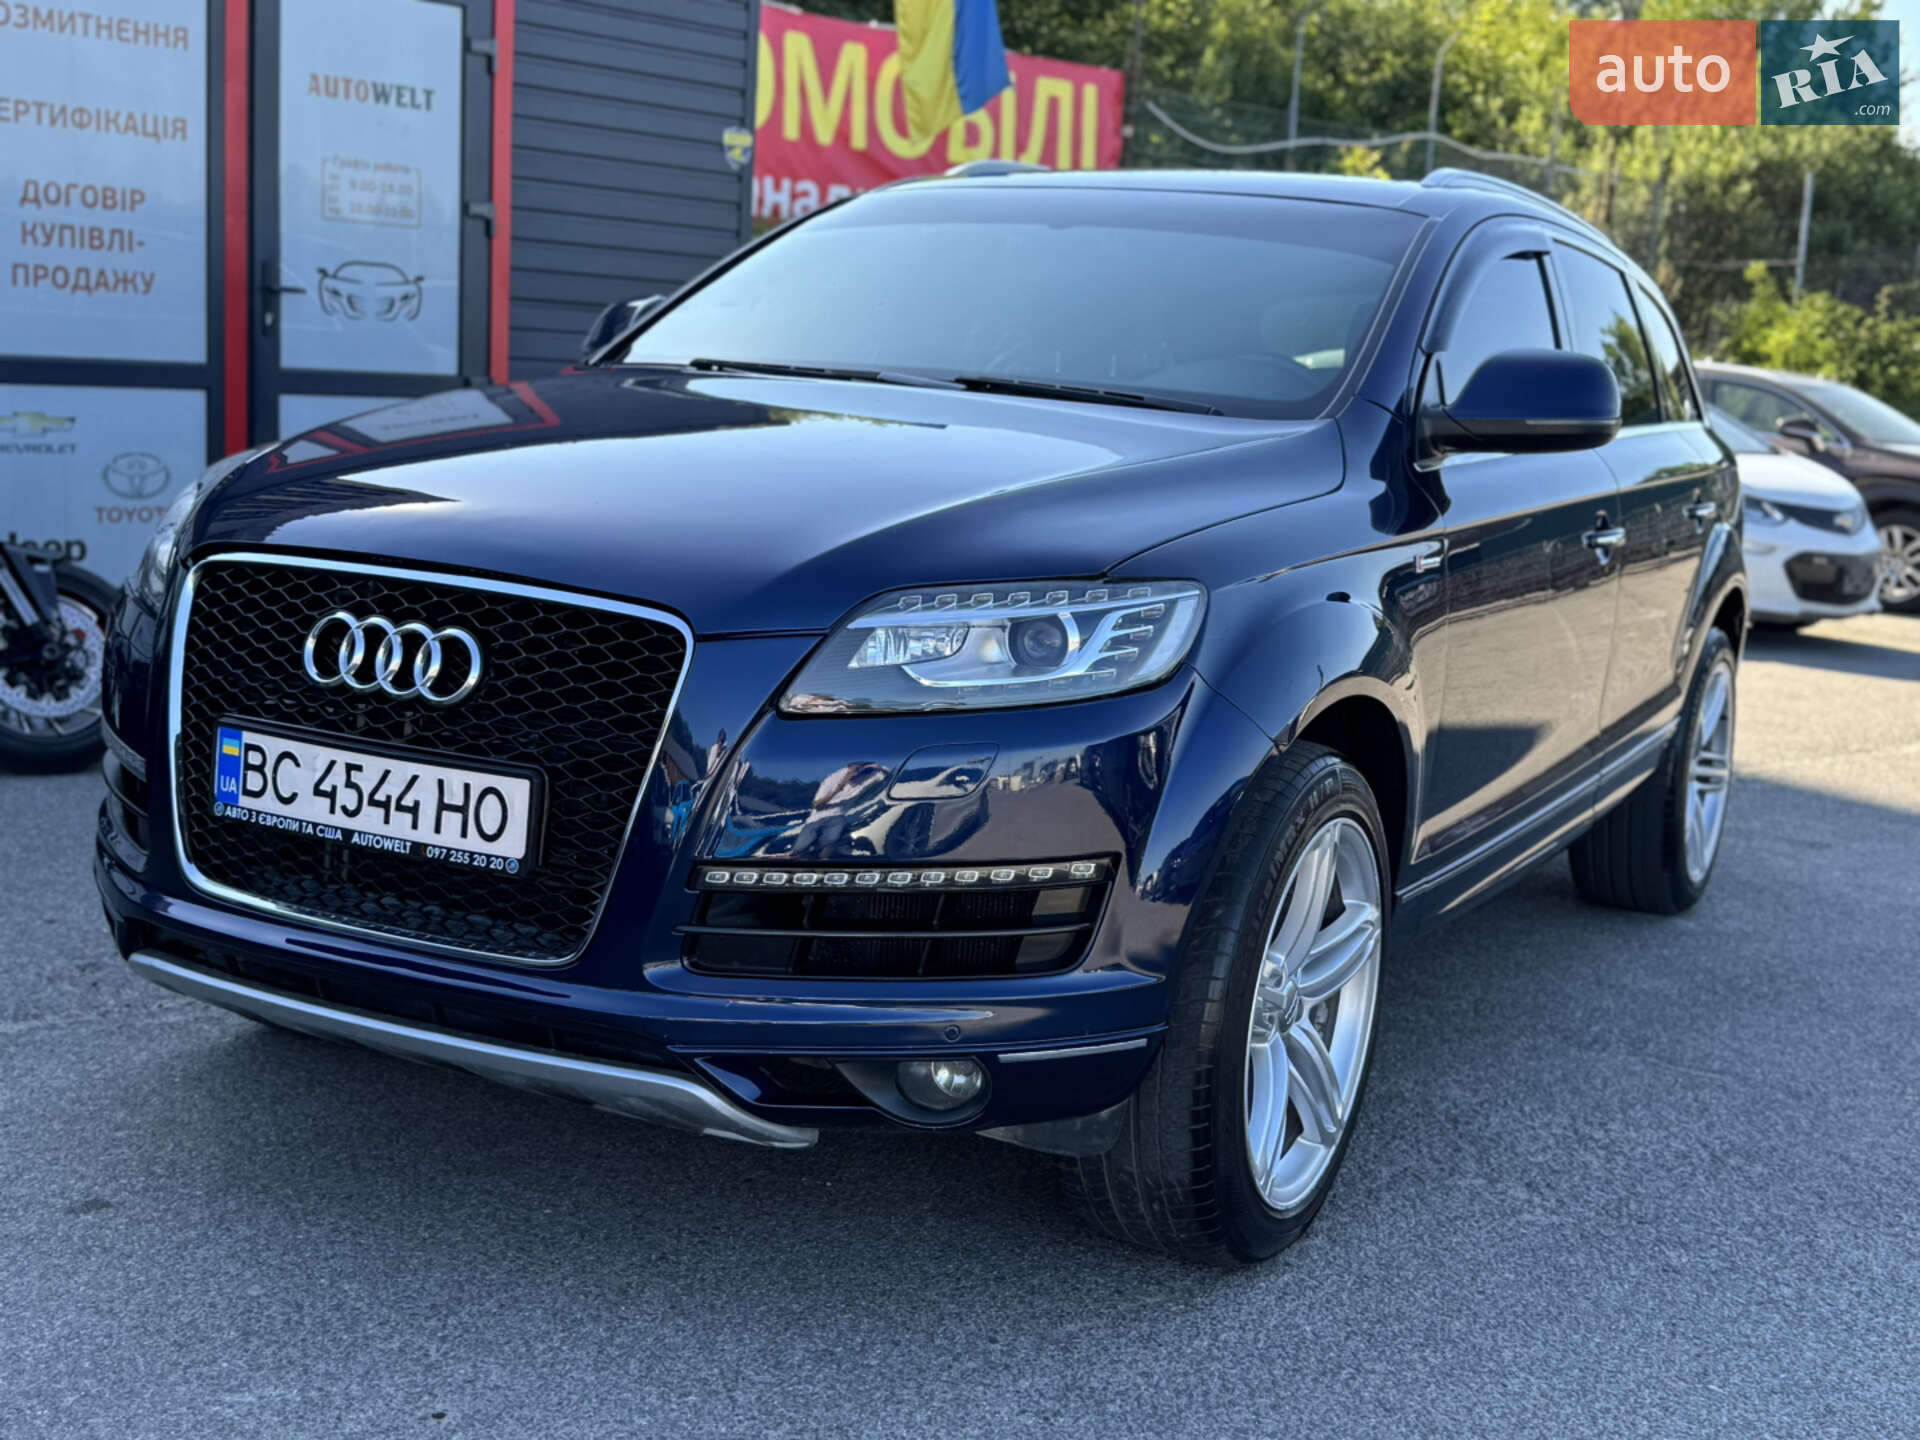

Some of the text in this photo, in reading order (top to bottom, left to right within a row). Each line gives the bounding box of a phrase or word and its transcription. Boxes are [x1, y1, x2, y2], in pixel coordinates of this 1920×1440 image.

[307, 72, 436, 112] AUTOWELT
[19, 179, 146, 212] ДОГОВІР
[20, 221, 146, 253] КУПІВЛІ-
[11, 263, 156, 295] ПРОДАЖУ
[0, 442, 77, 455] EVROLET
[220, 774, 238, 795] UA
[241, 742, 509, 844] BC 4544 HO
[224, 801, 249, 821] АВТО
[302, 822, 314, 836] ТА
[316, 825, 343, 841] США
[351, 832, 412, 855] AUTOWELT
[426, 845, 504, 871] 097 255 20 20
